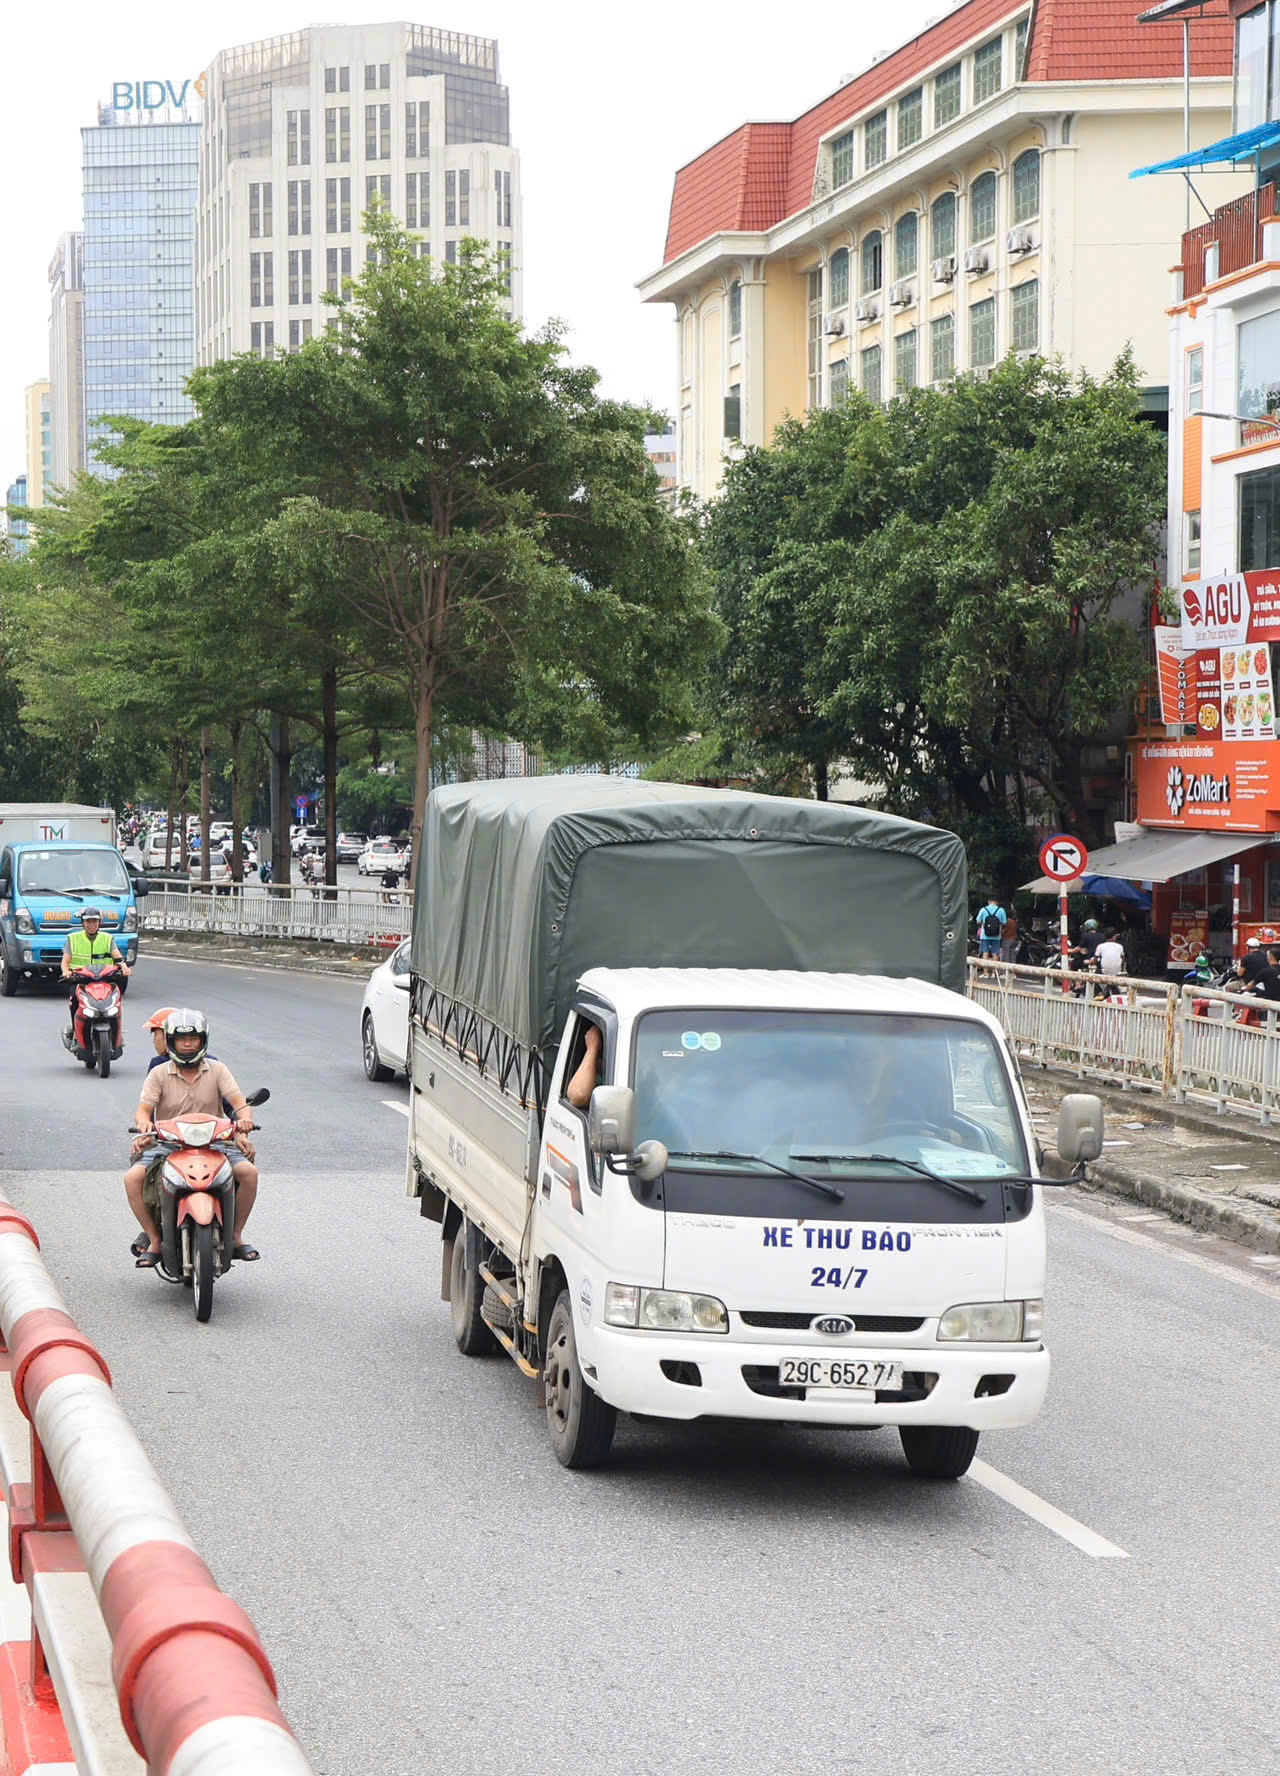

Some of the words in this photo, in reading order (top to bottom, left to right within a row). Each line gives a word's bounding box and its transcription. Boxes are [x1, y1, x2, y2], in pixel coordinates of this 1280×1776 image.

[113, 79, 191, 110] BIDV
[1205, 581, 1241, 626] AGU
[1178, 660, 1187, 721] ZOMART
[1186, 774, 1229, 801] ZoMart
[40, 823, 66, 840] TM
[763, 1226, 793, 1247] XE
[803, 1227, 853, 1249] THƯ
[862, 1226, 911, 1252] BÁO
[912, 1226, 1002, 1238] FRONTIER
[811, 1266, 868, 1290] 24/7
[821, 1319, 848, 1332] KIA
